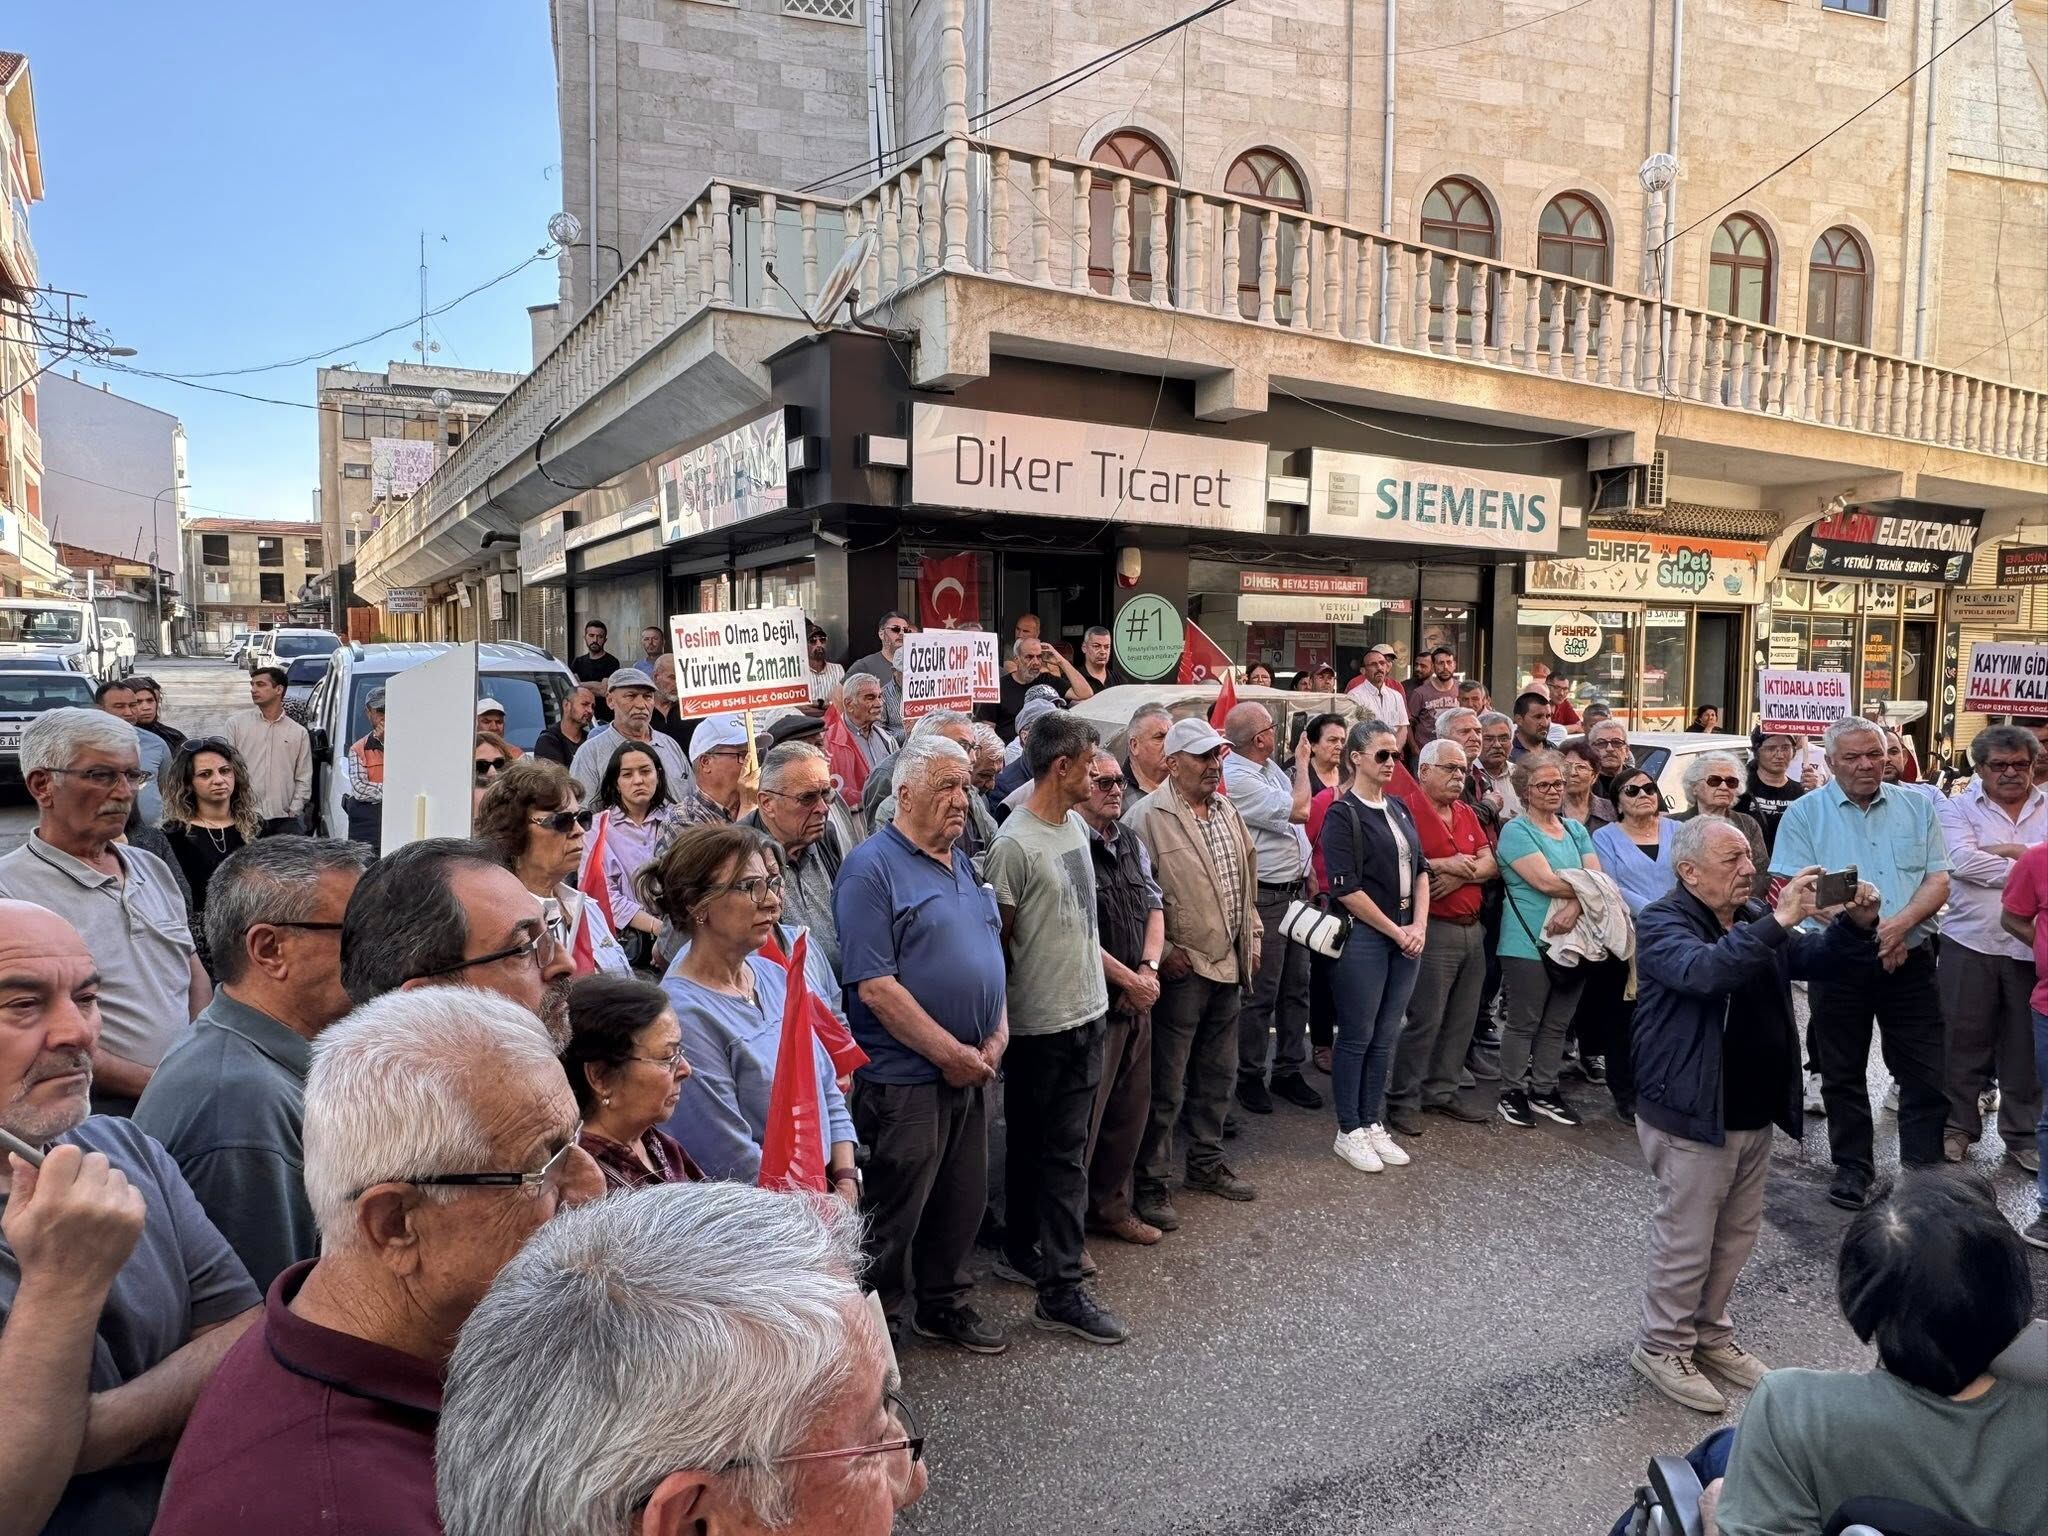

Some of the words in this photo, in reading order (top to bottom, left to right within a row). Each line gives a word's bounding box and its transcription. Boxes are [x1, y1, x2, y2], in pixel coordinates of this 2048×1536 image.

[956, 436, 1073, 493] Diker
[1091, 450, 1231, 508] Ticaret
[1375, 478, 1546, 533] SIEMENS
[1586, 541, 1650, 563] OYRAZ
[1678, 548, 1710, 571] Pet
[1843, 555, 1874, 570] YETKİLİ
[1875, 557, 1904, 571] TEKNİK
[1904, 559, 1931, 573] SERVİS
[1244, 574, 1280, 590] DİKER
[1283, 580, 1308, 589] BEYAZ
[1309, 582, 1329, 592] EŞYA
[1659, 563, 1706, 591] Shop
[675, 625, 721, 649] Teslim
[724, 624, 759, 645] Olma
[762, 620, 799, 646] Değil,
[1554, 625, 1597, 636] POYRAZ
[974, 641, 993, 660] AY,
[1572, 638, 1588, 649] Pet
[910, 642, 946, 673] ÖZGÜR
[949, 645, 968, 670] CHP
[1975, 653, 2022, 674] KAYYIM
[678, 656, 741, 689] Yürüme
[745, 652, 801, 682] Zamanı
[974, 661, 993, 686] N!
[909, 676, 936, 699] ÖZGÜR
[937, 673, 969, 696] TÜRKİYE
[1764, 676, 1814, 697] İKTİDARLA
[1816, 678, 1845, 697] DEĞİL
[1970, 677, 2012, 698] HALK
[701, 700, 720, 709] CHP
[722, 696, 747, 707] EŞME
[748, 694, 768, 705] İLÇE
[770, 688, 806, 700] ÖRGÜTÜ
[1765, 700, 1799, 719] İKTİDARA
[1801, 702, 1845, 721] YÜRÜYORUZ
